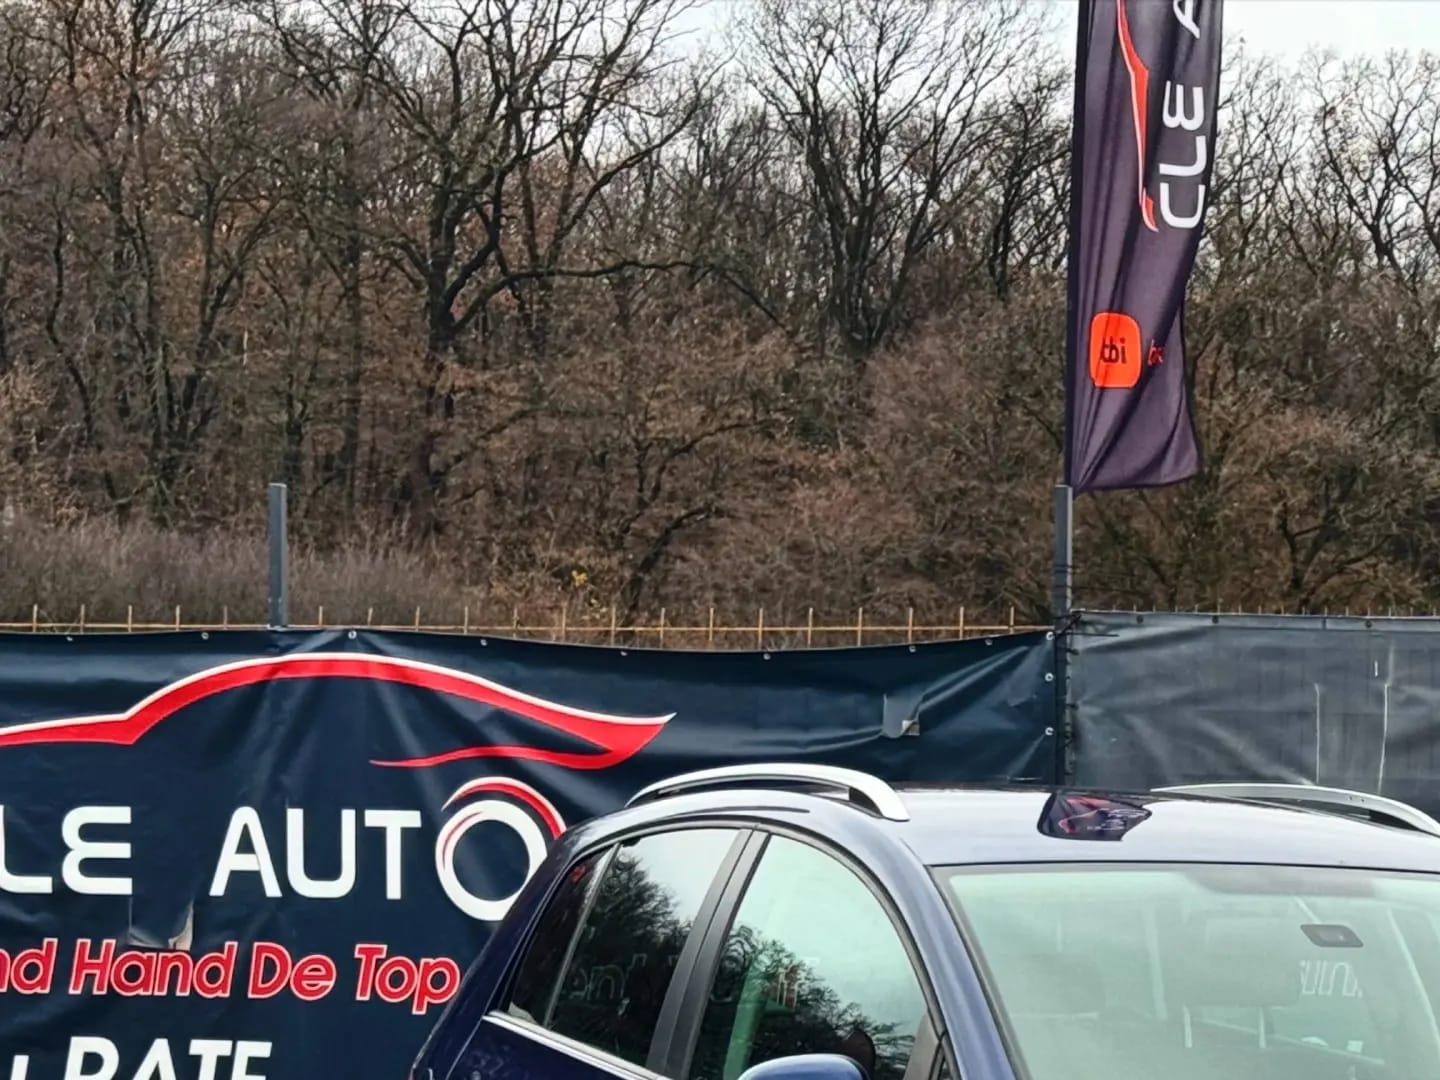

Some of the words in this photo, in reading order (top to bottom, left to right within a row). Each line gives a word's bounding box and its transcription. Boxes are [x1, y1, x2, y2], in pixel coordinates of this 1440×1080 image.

[1159, 80, 1208, 229] CLE
[209, 800, 547, 920] AUTO
[69, 938, 238, 998] Hand
[248, 941, 336, 999] De
[355, 945, 460, 1014] Top
